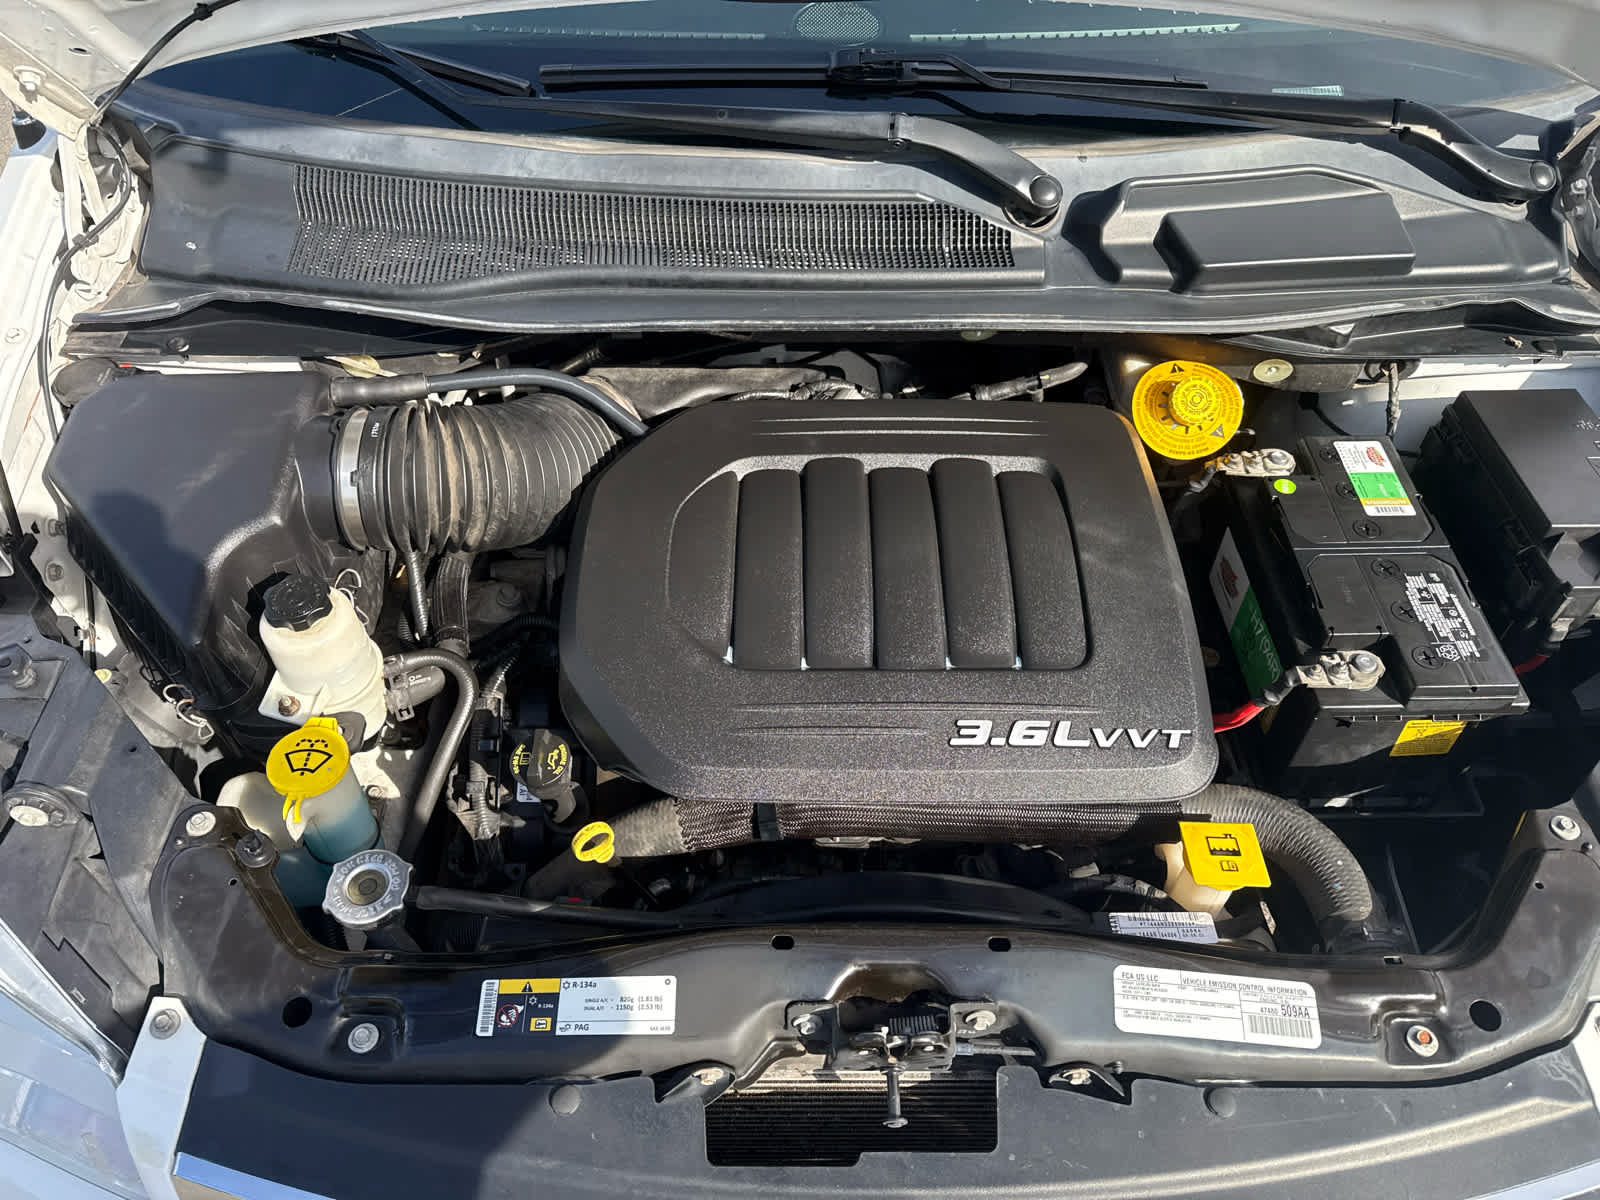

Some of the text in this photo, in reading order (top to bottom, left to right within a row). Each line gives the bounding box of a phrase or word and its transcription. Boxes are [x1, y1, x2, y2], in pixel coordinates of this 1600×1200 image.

[572, 981, 597, 989] R-134a
[1182, 977, 1308, 995] VEHICLE EMISSION CONTROL INFORMATION
[615, 1004, 634, 1012] 1150g
[1280, 1004, 1310, 1018] 509AA
[573, 1023, 590, 1031] PAG
